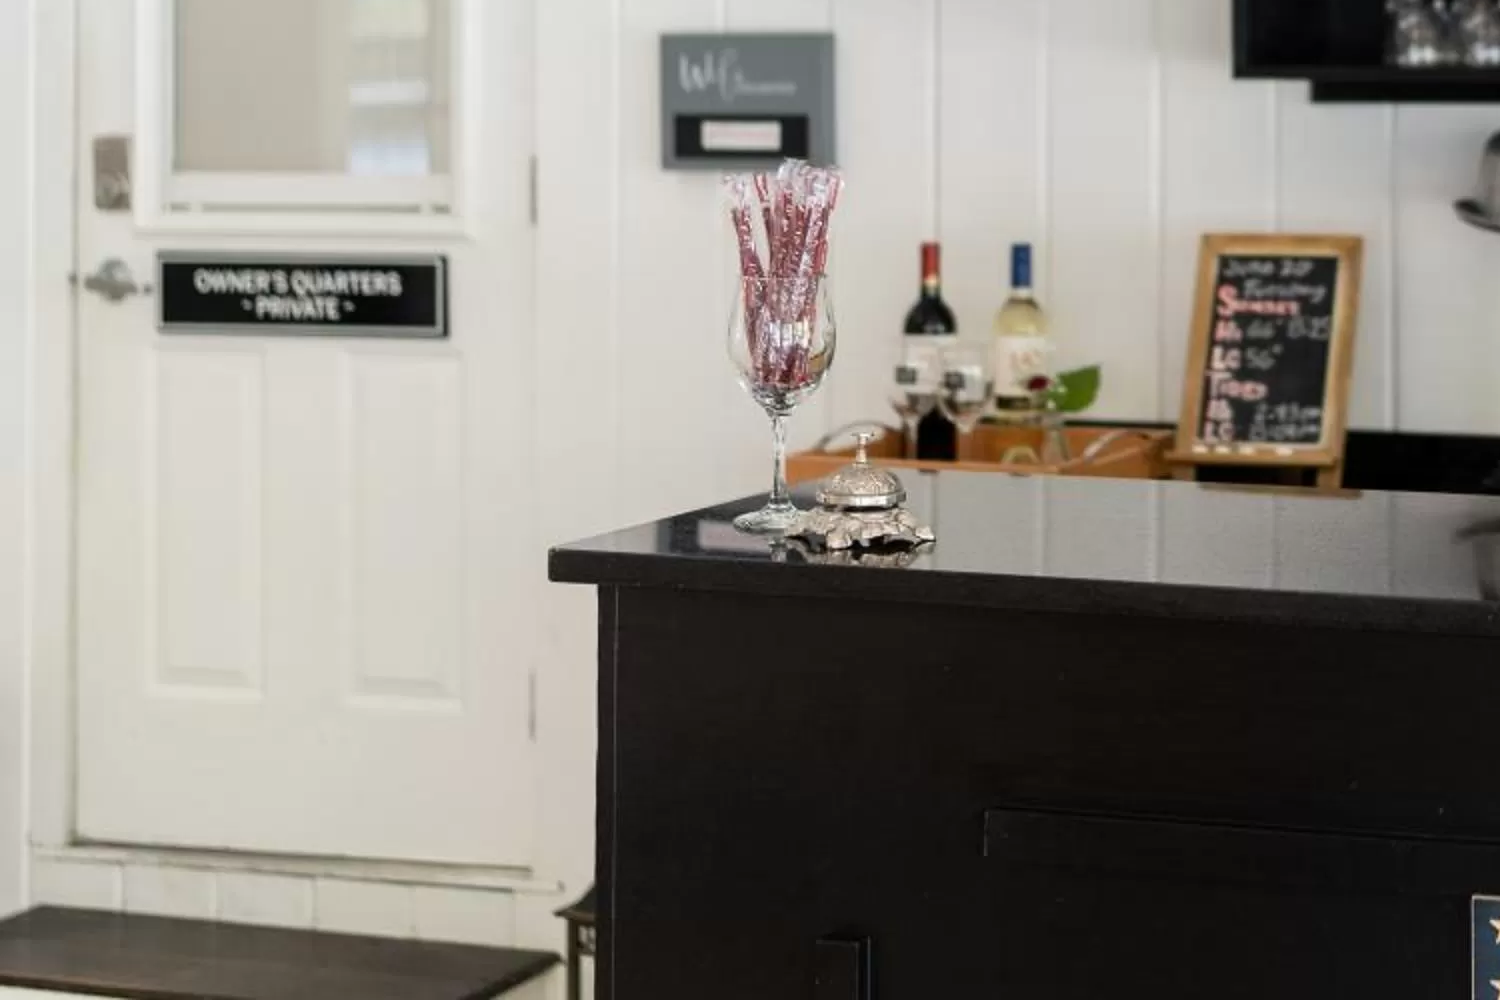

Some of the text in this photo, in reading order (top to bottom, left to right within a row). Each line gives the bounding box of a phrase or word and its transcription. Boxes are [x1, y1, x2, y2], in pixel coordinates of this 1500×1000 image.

[193, 268, 402, 297] OWNER'S QUARTERS
[255, 295, 340, 321] PRIVATE
